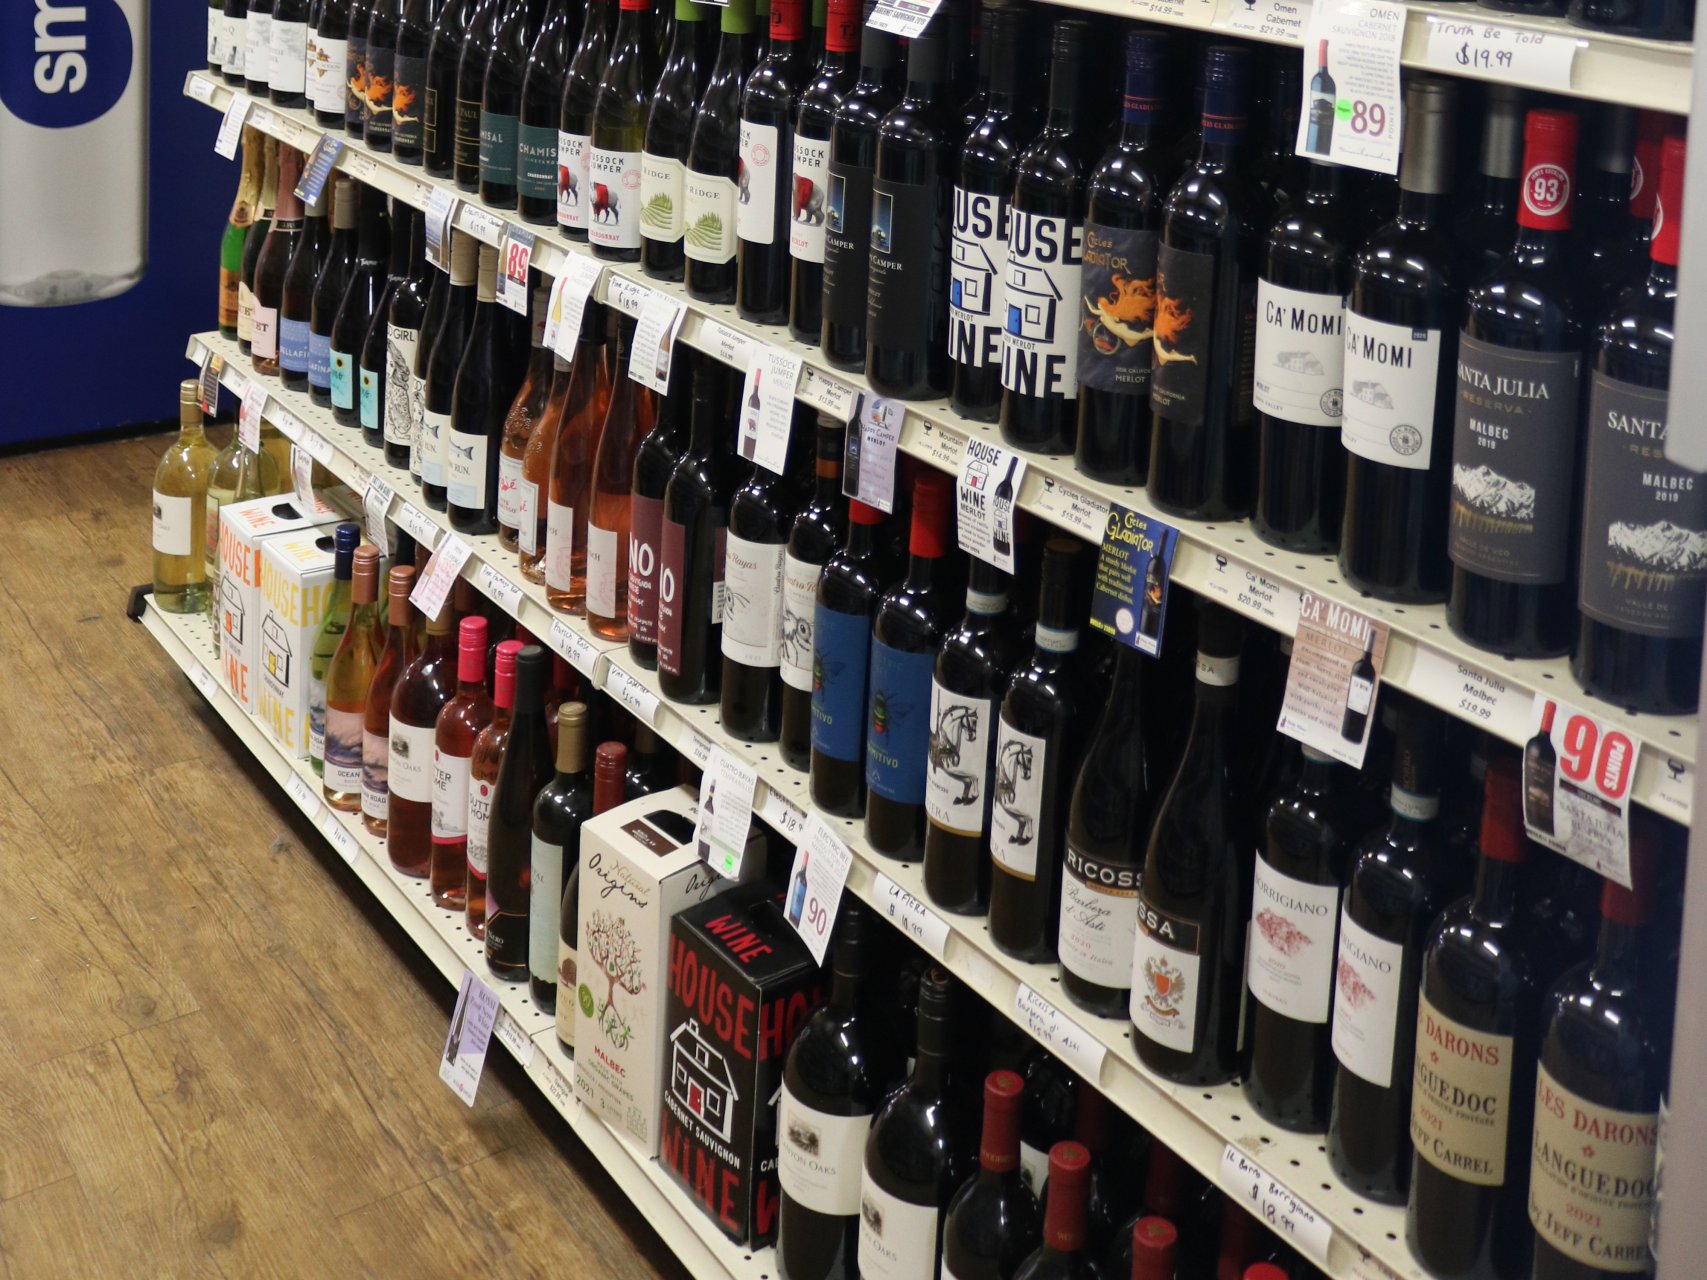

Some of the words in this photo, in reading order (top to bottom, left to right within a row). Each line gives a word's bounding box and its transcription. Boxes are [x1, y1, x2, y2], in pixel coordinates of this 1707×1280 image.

[1274, 3, 1297, 14] Omen
[1370, 8, 1400, 21] OMEN
[1266, 14, 1301, 27] Cabernet
[1358, 21, 1396, 32] CABERNET
[1331, 26, 1377, 40] SAUVIGNON
[1437, 22, 1473, 36] Truth
[1483, 27, 1500, 39] Be
[1515, 32, 1545, 45] Told
[1456, 42, 1512, 67] $19.99
[1351, 101, 1385, 136] 89
[520, 144, 557, 157] CHAMIS
[644, 168, 670, 180] RIDGE
[690, 186, 720, 199] RIDGE
[1534, 178, 1558, 201] 93
[508, 244, 528, 280] 89
[955, 310, 973, 322] MERLOT
[1291, 308, 1341, 335] MOMI
[394, 330, 415, 342] GIRL
[1012, 339, 1035, 350] MERLOT
[768, 354, 796, 369] TUSSOCK
[1363, 336, 1412, 368] MOMI
[818, 375, 833, 389] Happy
[834, 381, 852, 395] Camper
[1115, 374, 1145, 384] MERLOT
[1494, 377, 1549, 399] JULIA
[826, 389, 841, 400] Merlot
[939, 431, 963, 447] Mountain
[1470, 418, 1508, 440] MALBEC
[867, 436, 885, 447] MERLOT
[940, 443, 957, 456] Merlot
[967, 440, 1002, 465] HOUSE
[1643, 473, 1693, 491] MALBEC
[960, 487, 985, 510] WINE
[1058, 486, 1078, 501] Cycles
[1080, 494, 1108, 514] Gladiator
[960, 503, 985, 519] MERLOT
[1071, 502, 1091, 518] Merlot
[283, 541, 320, 562] WINE
[1102, 543, 1129, 562] MERLOT
[261, 557, 298, 627] HOUSE
[1249, 584, 1272, 603] Merlot
[1259, 577, 1280, 593] Momi
[1237, 593, 1262, 610] $20.99
[1301, 594, 1325, 622] CA'
[1326, 603, 1369, 641] MOMI
[1306, 633, 1348, 655] MERLOT
[1457, 664, 1483, 682] Santa
[1484, 676, 1505, 693] Julia
[1463, 684, 1497, 705] Malbec
[1459, 699, 1491, 720] $19.99
[1559, 714, 1633, 799] 90
[1603, 740, 1625, 791] POINTS
[371, 795, 386, 803] ROAD
[808, 897, 826, 935] 90
[705, 914, 772, 963] WINE
[669, 934, 754, 1060] HOUSE
[1426, 1015, 1499, 1066] DARONS
[594, 1045, 626, 1078] MALBEC
[576, 1074, 594, 1098] 2021
[1539, 1077, 1565, 1120] LES
[1420, 1104, 1444, 1131] 2021
[664, 1090, 693, 1131] CABERNET
[696, 1126, 740, 1169] SAUVIGNON
[1433, 1139, 1493, 1174] CARREL
[661, 1109, 738, 1231] WINE
[1566, 1203, 1601, 1227] 2021
[1546, 1211, 1582, 1246] JEFF
